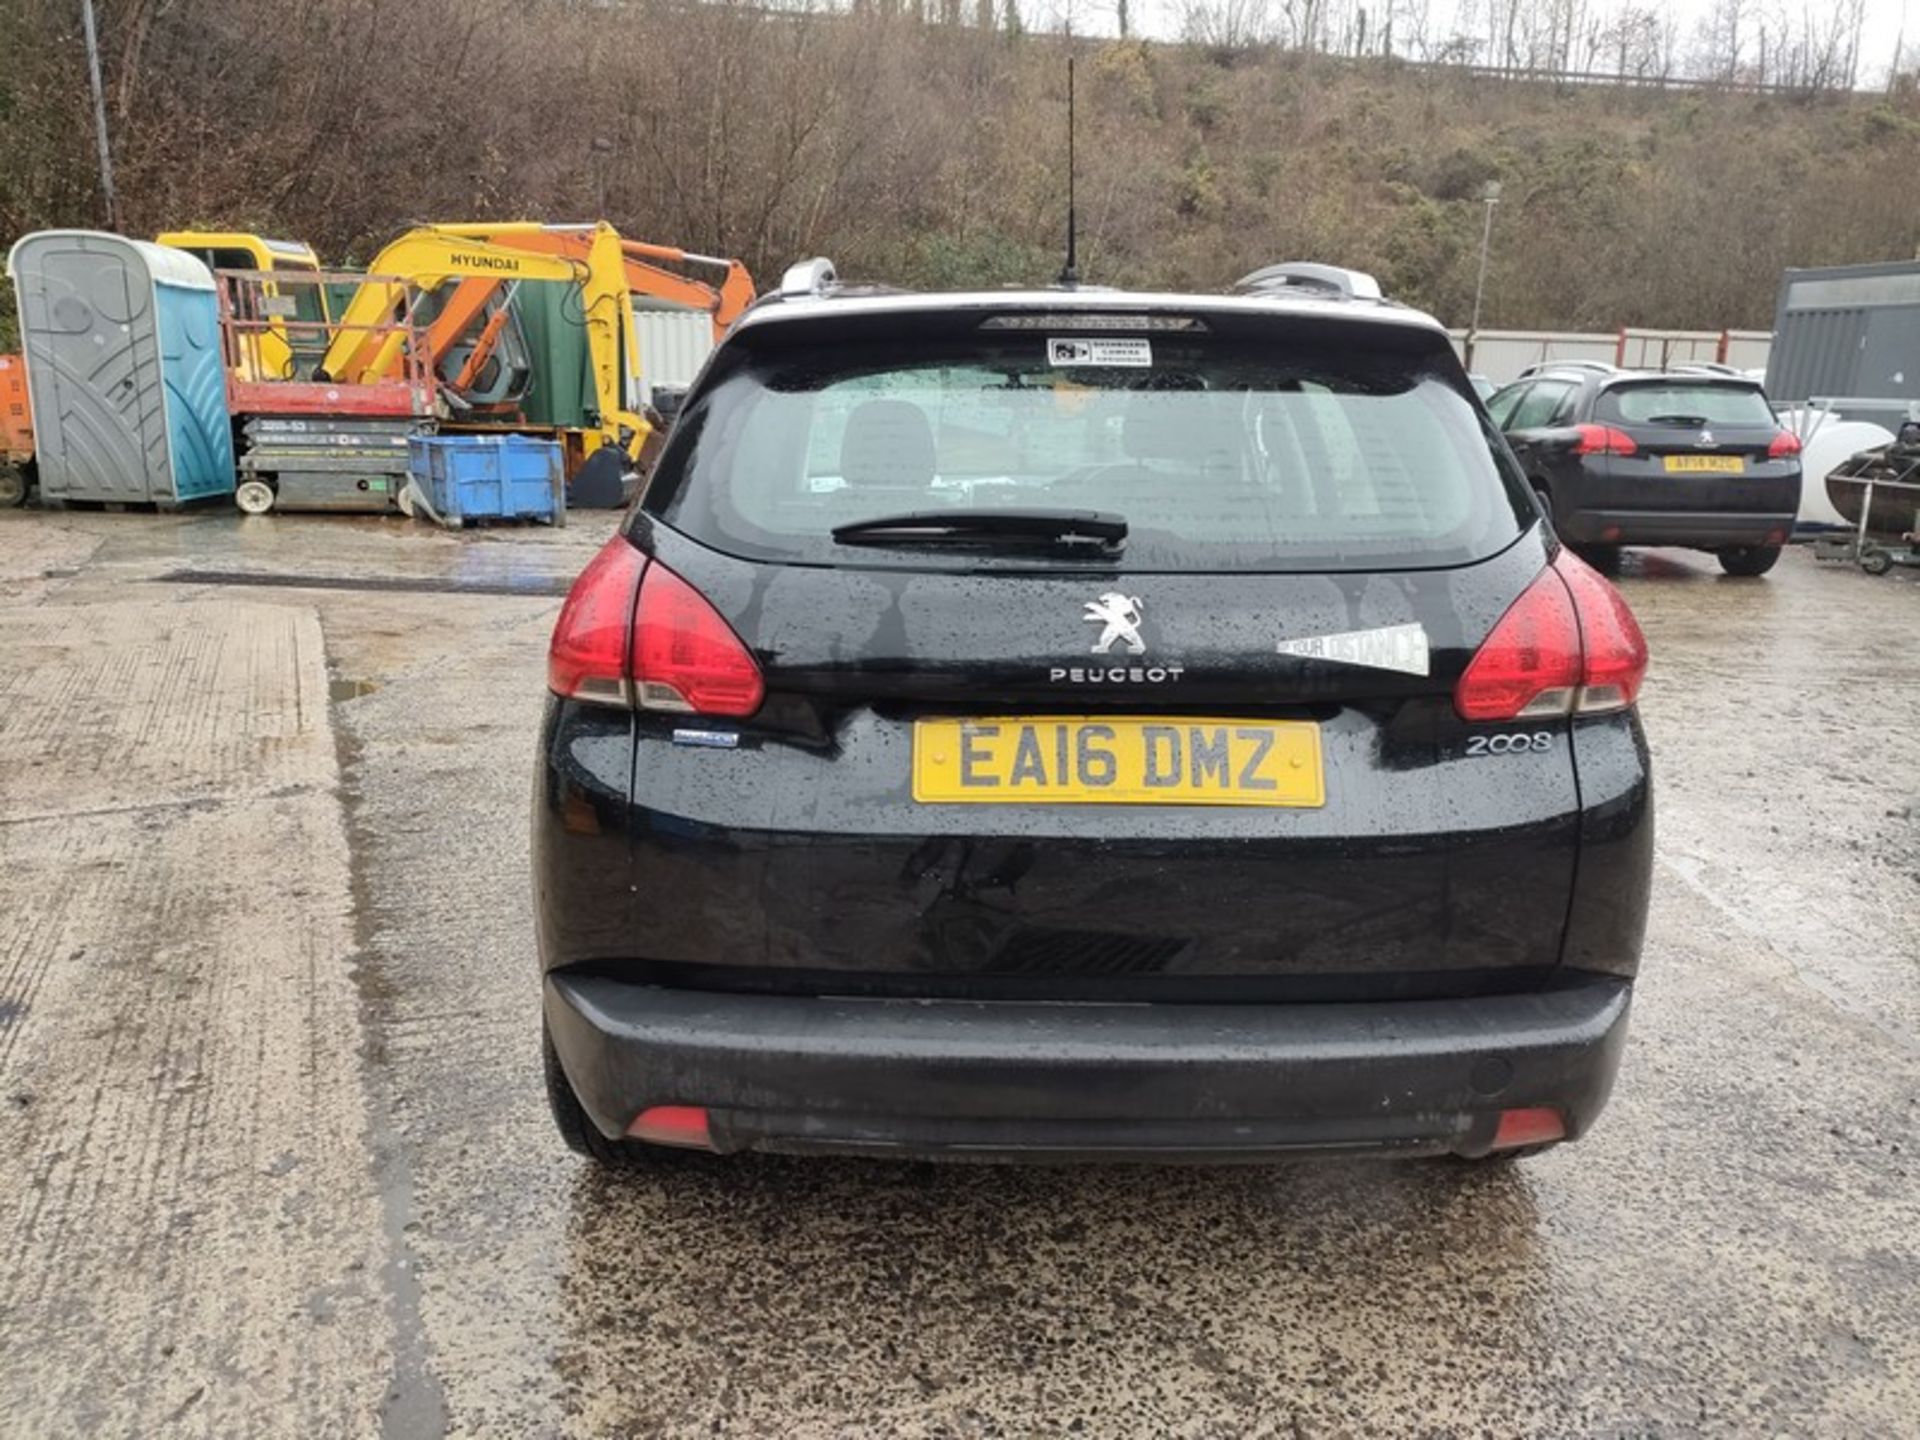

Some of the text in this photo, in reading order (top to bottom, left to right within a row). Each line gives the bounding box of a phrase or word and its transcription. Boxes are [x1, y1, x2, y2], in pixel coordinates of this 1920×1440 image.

[450, 253, 519, 271] HYUNDAI
[1293, 637, 1325, 657] YOUR
[1050, 667, 1184, 683] PEUGEOT
[1465, 731, 1552, 755] 2008
[959, 724, 1278, 790] EA16 DMZ
